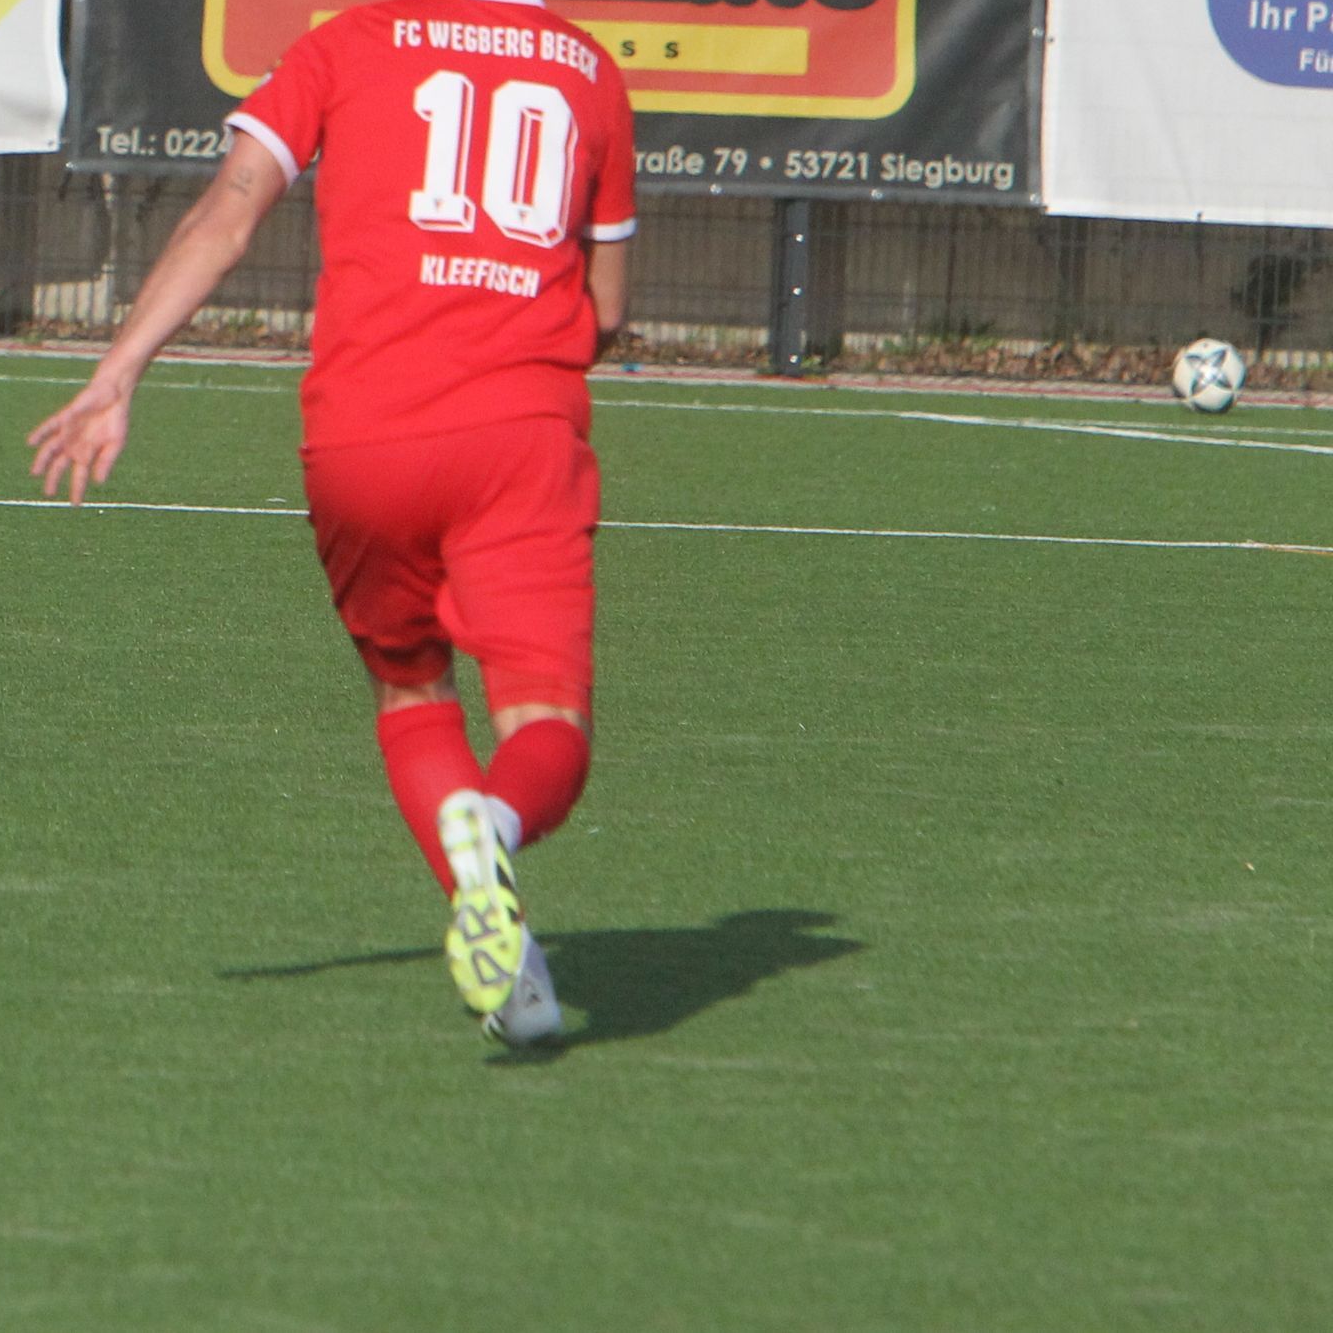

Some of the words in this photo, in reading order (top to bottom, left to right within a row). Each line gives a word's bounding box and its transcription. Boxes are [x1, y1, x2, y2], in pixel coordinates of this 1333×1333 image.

[394, 19, 422, 48] FC
[426, 20, 534, 59] WEGBERG
[97, 126, 156, 157] Tel.:
[408, 69, 579, 250] 10
[713, 148, 749, 176] 79
[784, 150, 870, 181] 53721
[880, 152, 1015, 191] Siegburg
[419, 253, 541, 299] KLEEFISCH
